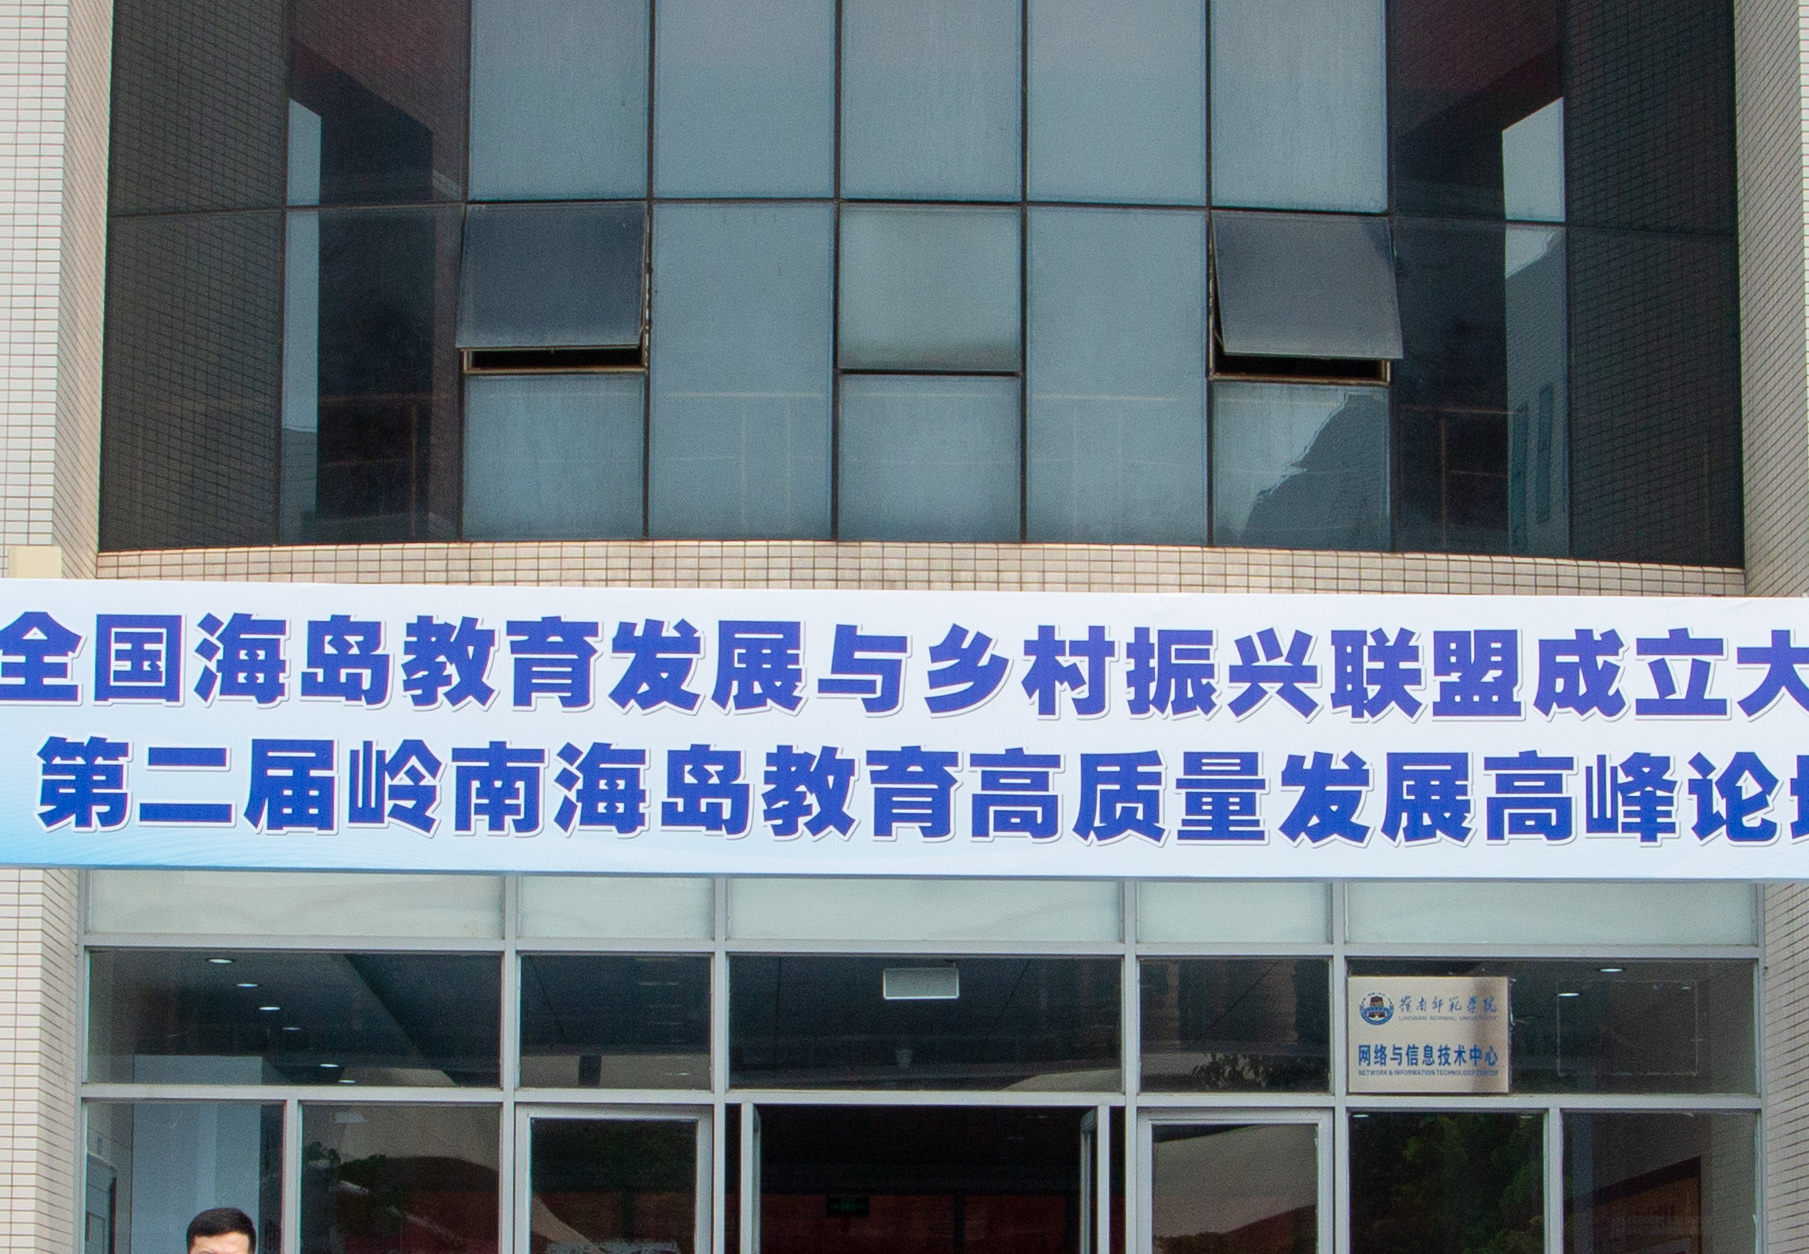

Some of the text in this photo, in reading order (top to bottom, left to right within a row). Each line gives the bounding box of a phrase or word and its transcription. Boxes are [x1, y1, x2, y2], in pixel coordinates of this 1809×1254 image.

[1358, 1044, 1498, 1067] 网络与信息技术中心
